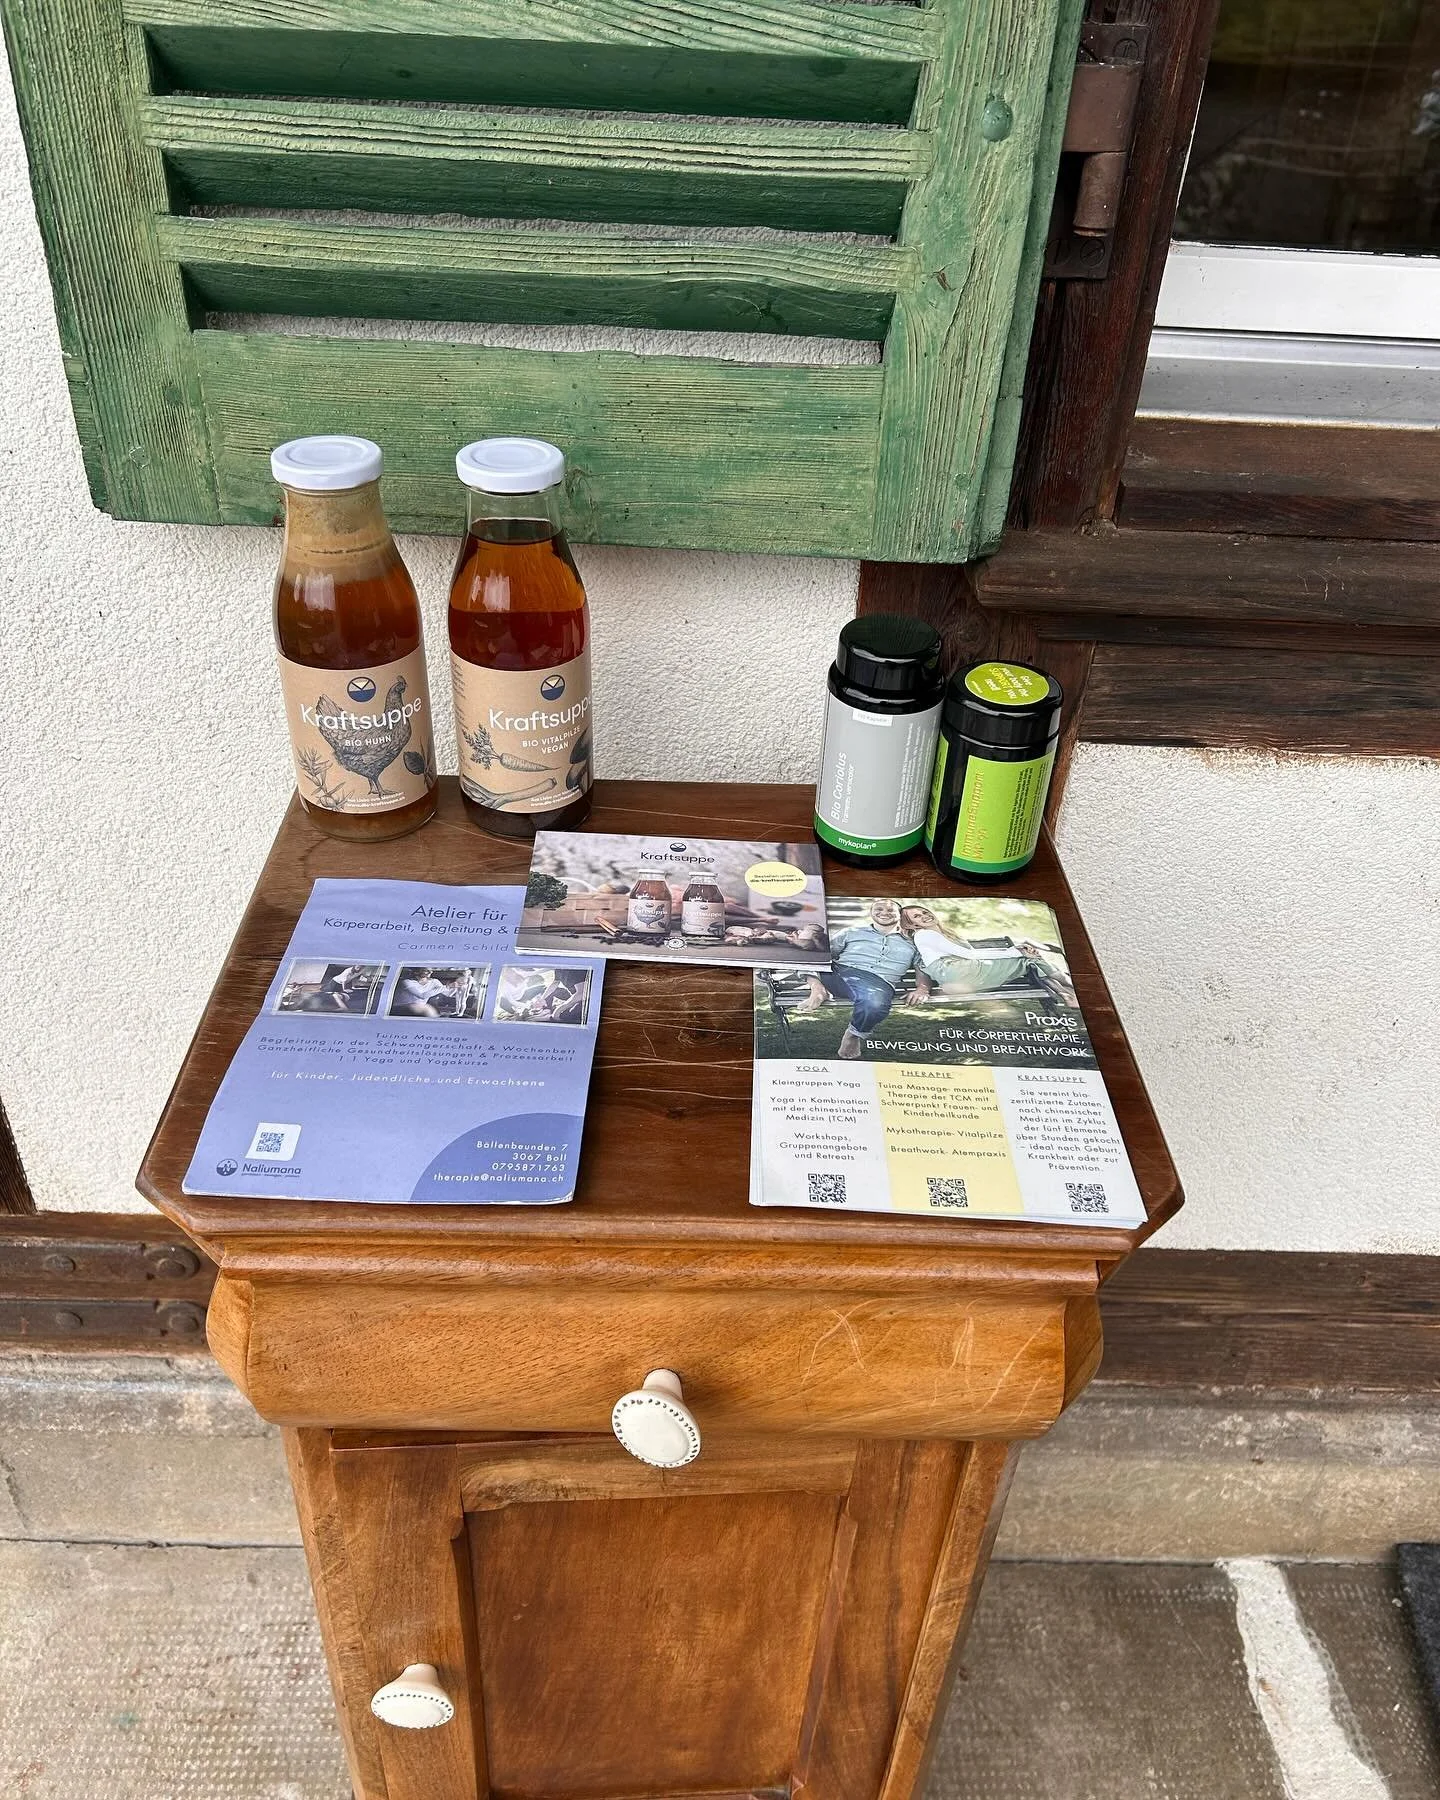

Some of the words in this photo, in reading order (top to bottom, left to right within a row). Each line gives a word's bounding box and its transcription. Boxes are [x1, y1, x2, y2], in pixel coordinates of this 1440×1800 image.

[300, 697, 422, 730] Kraftsuppe
[489, 696, 591, 731] Kraftsupp
[345, 739, 361, 747] BIO
[366, 734, 391, 746] HUHN
[522, 740, 538, 748] BIO
[541, 725, 580, 745] VITALPILZE
[541, 741, 569, 754] VEGAN
[833, 752, 847, 799] Coriolus
[830, 800, 841, 820] Bio
[641, 852, 714, 864] Kraftsuppe
[411, 904, 475, 919] Atelier
[483, 908, 508, 920] für
[324, 918, 414, 932] Körperarbeit,
[421, 923, 492, 936] Begleitung
[497, 926, 508, 934] &
[398, 942, 454, 950] Carmen
[1024, 1011, 1078, 1028] Praxis
[375, 1032, 408, 1040] Tuina
[414, 1034, 468, 1042] Massage
[939, 1028, 964, 1039] FÜR
[968, 1029, 1085, 1045] KÖRPERTHERAPIE,
[260, 1036, 327, 1045] Begleitung
[376, 1040, 483, 1050] Schwangerschaft
[503, 1046, 576, 1054] Wochenbett
[866, 1040, 951, 1051] BEWEGUNG
[956, 1043, 988, 1053] UND
[993, 1045, 1090, 1058] BREATHWORK
[257, 1044, 342, 1053] Ganzheitliche
[493, 1053, 573, 1062] Prozessarbeit
[365, 1056, 394, 1064] Yoga
[271, 1071, 288, 1079] für
[437, 1076, 460, 1084] und
[468, 1077, 545, 1087] Erwachsene
[900, 1070, 954, 1079] THERAPIE
[1017, 1074, 1085, 1083] KRAFTSUPPE
[837, 1080, 861, 1088] Yoga
[879, 1082, 903, 1090] Tuina
[887, 1091, 928, 1100] Therapie
[770, 1096, 794, 1104] Yoga
[811, 1097, 869, 1105] Kombination
[881, 1099, 940, 1109] Schwerpunkt
[809, 1106, 869, 1114] chinesischen
[1044, 1108, 1102, 1116] chinesischer
[828, 1115, 857, 1123] (TCM)
[903, 1110, 980, 1120] Kinderheilkunde
[957, 1130, 1004, 1139] Vitalpilze
[1065, 1126, 1107, 1134] Elemente
[1041, 1134, 1080, 1142] Stunden
[780, 1142, 868, 1151] Gruppenangebote
[1085, 1146, 1121, 1154] Geburt,
[952, 1149, 1007, 1158] Atempraxis
[1028, 1153, 1075, 1161] Krankheit
[242, 1163, 301, 1174] Naliumana
[492, 1163, 565, 1172] 0795871763
[433, 1173, 564, 1182] therapie@naliumana.ch
